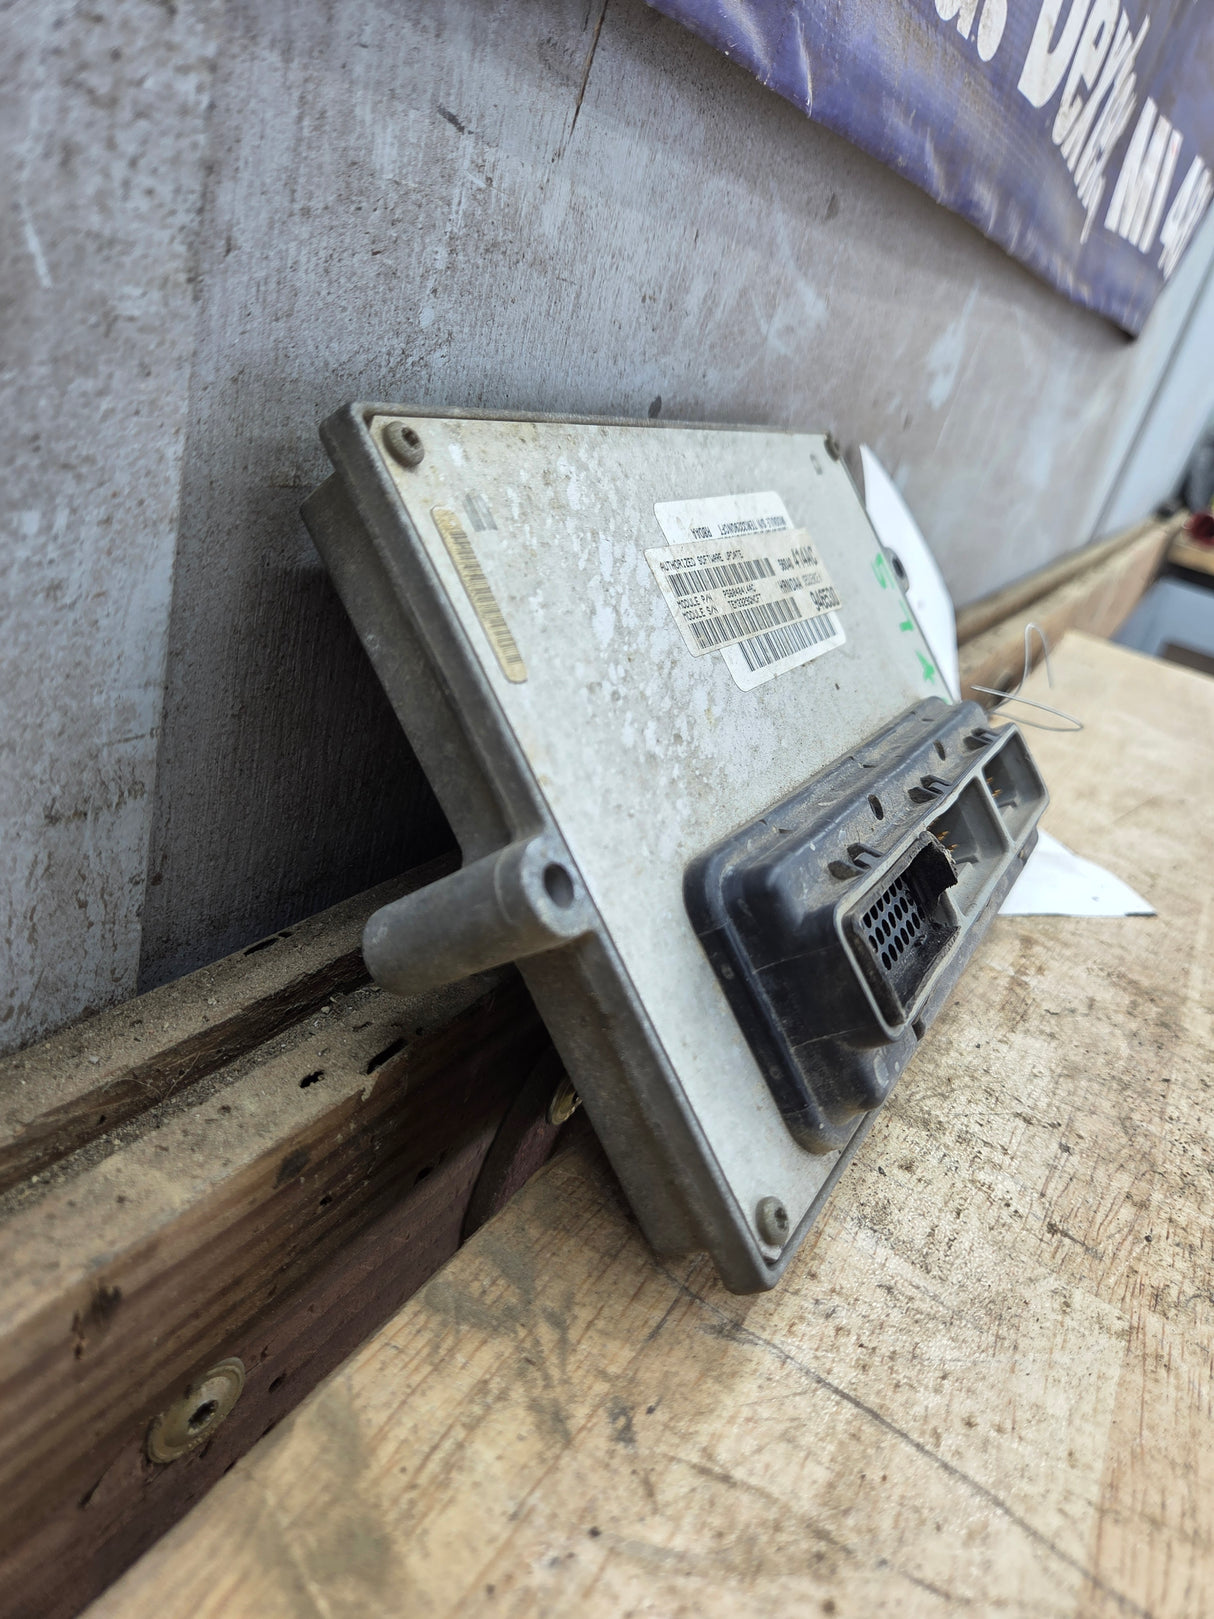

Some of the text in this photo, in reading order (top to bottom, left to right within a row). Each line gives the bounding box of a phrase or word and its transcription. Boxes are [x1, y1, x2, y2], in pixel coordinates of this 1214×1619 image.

[660, 549, 744, 572] AUTHORIZED SOFTWARE UPDATE
[676, 596, 701, 610] MODULE
[700, 593, 713, 605] P/N
[682, 607, 706, 621] MODULE
[706, 604, 720, 617] S/N
